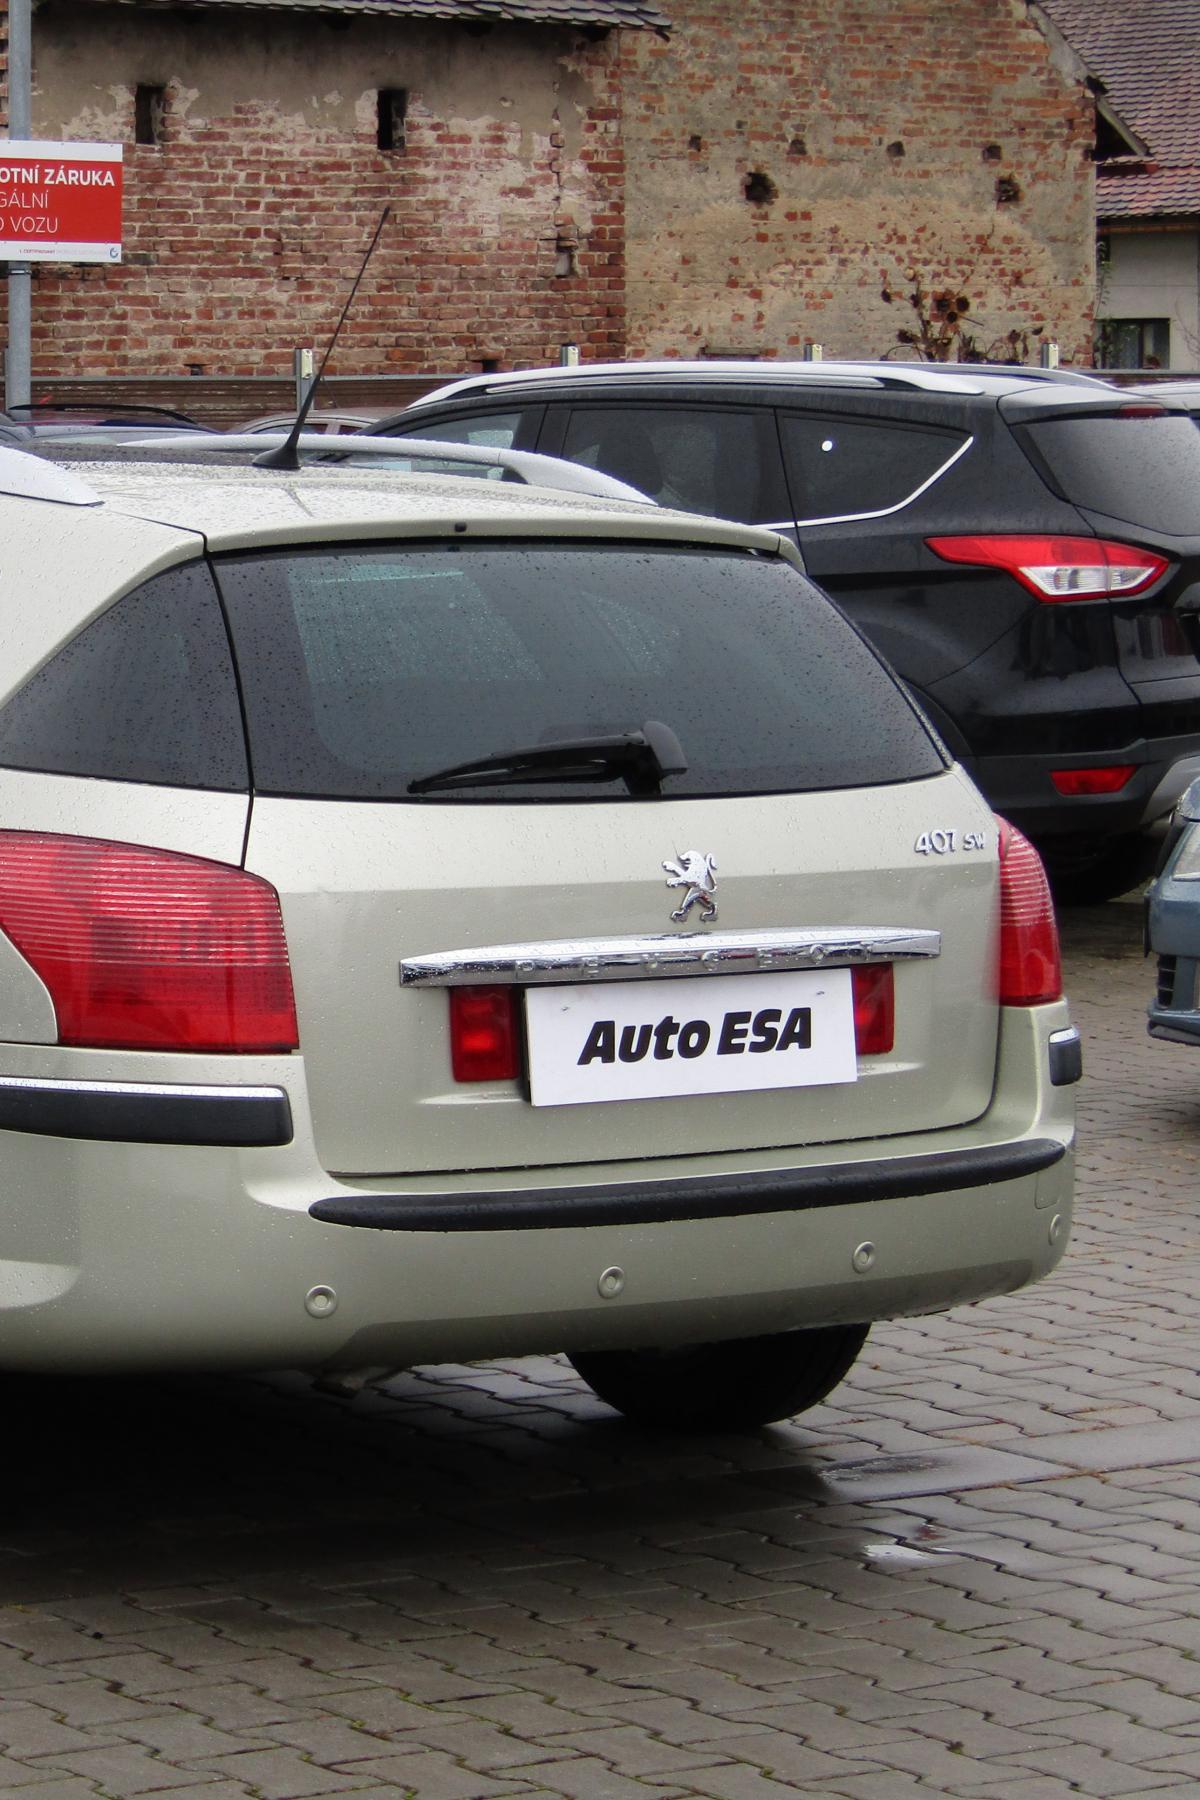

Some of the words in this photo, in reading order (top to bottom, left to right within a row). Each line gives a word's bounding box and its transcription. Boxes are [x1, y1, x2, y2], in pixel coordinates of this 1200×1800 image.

[44, 164, 115, 187] ZÁRUKA
[10, 216, 58, 234] VOZU
[913, 828, 958, 856] 407
[576, 1015, 711, 1066] Auto
[716, 1007, 812, 1056] ESA
